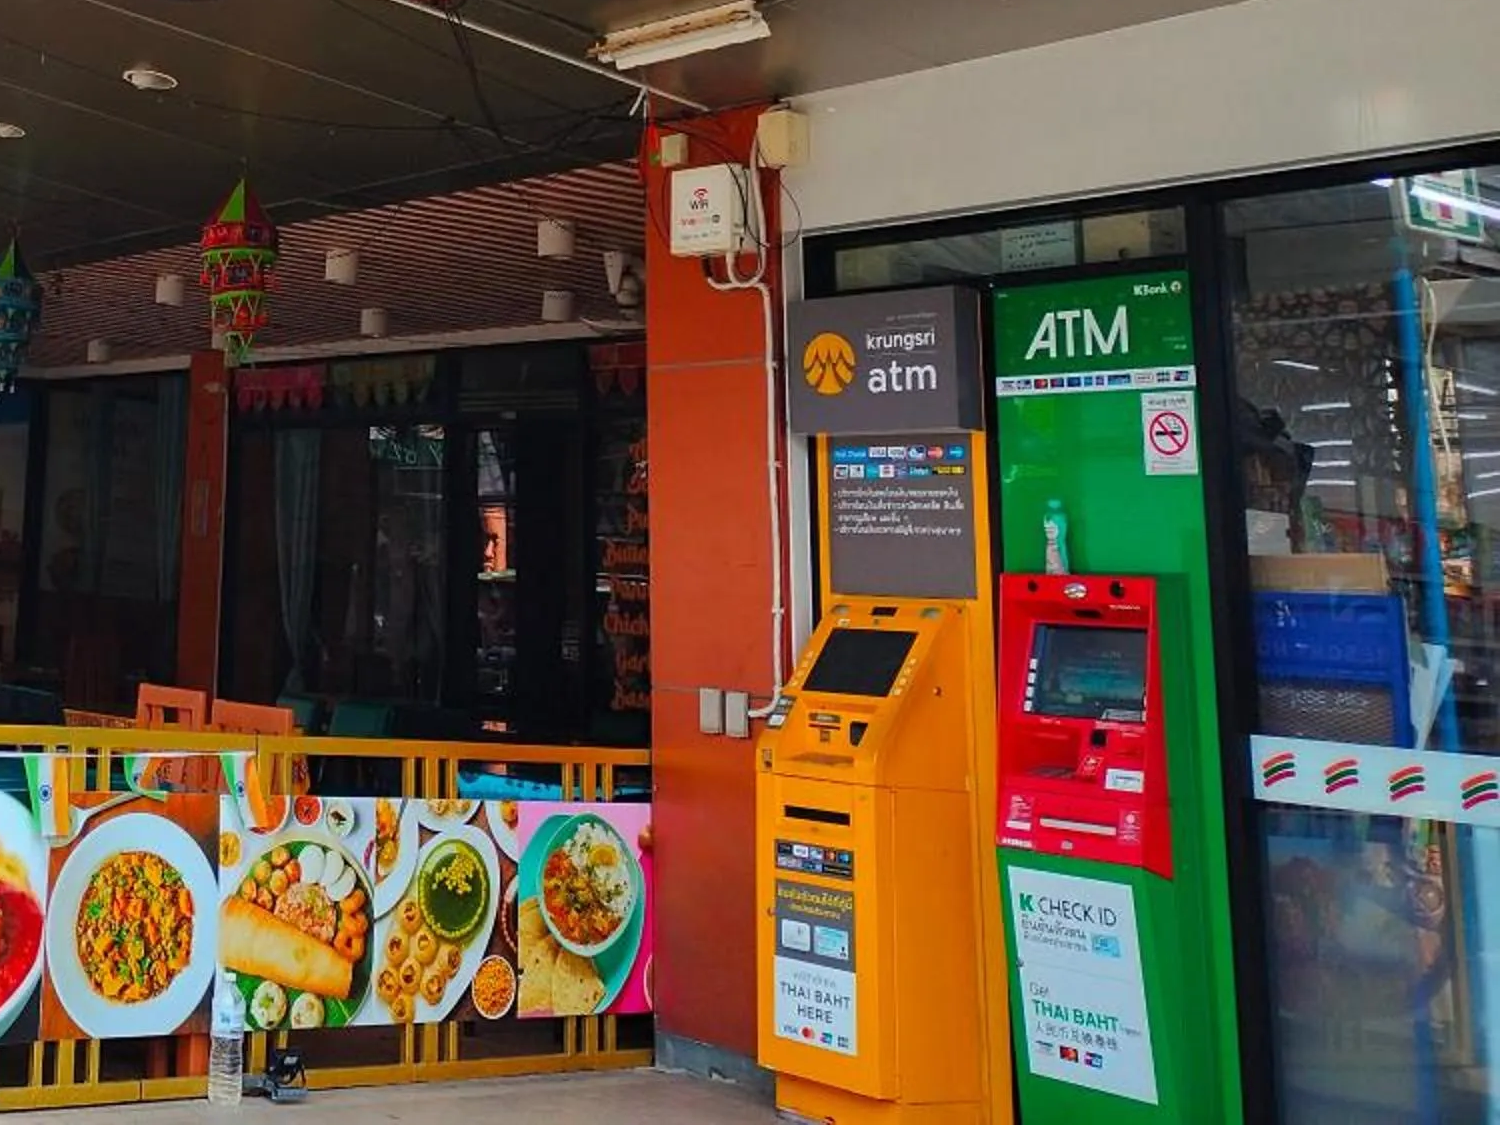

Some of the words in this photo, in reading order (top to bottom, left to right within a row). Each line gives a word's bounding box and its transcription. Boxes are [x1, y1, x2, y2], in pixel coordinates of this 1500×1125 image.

[866, 328, 936, 351] krungsri
[1024, 305, 1129, 360] ATM
[868, 360, 938, 394] atm
[1019, 893, 1035, 912] K
[1038, 897, 1095, 924] CHECK
[1098, 907, 1117, 927] ID
[780, 981, 810, 1001] THAI
[815, 990, 850, 1011] BAHT
[797, 1004, 833, 1025] HERE
[1031, 998, 1069, 1022] THAI
[1073, 1008, 1119, 1034] BAHT
